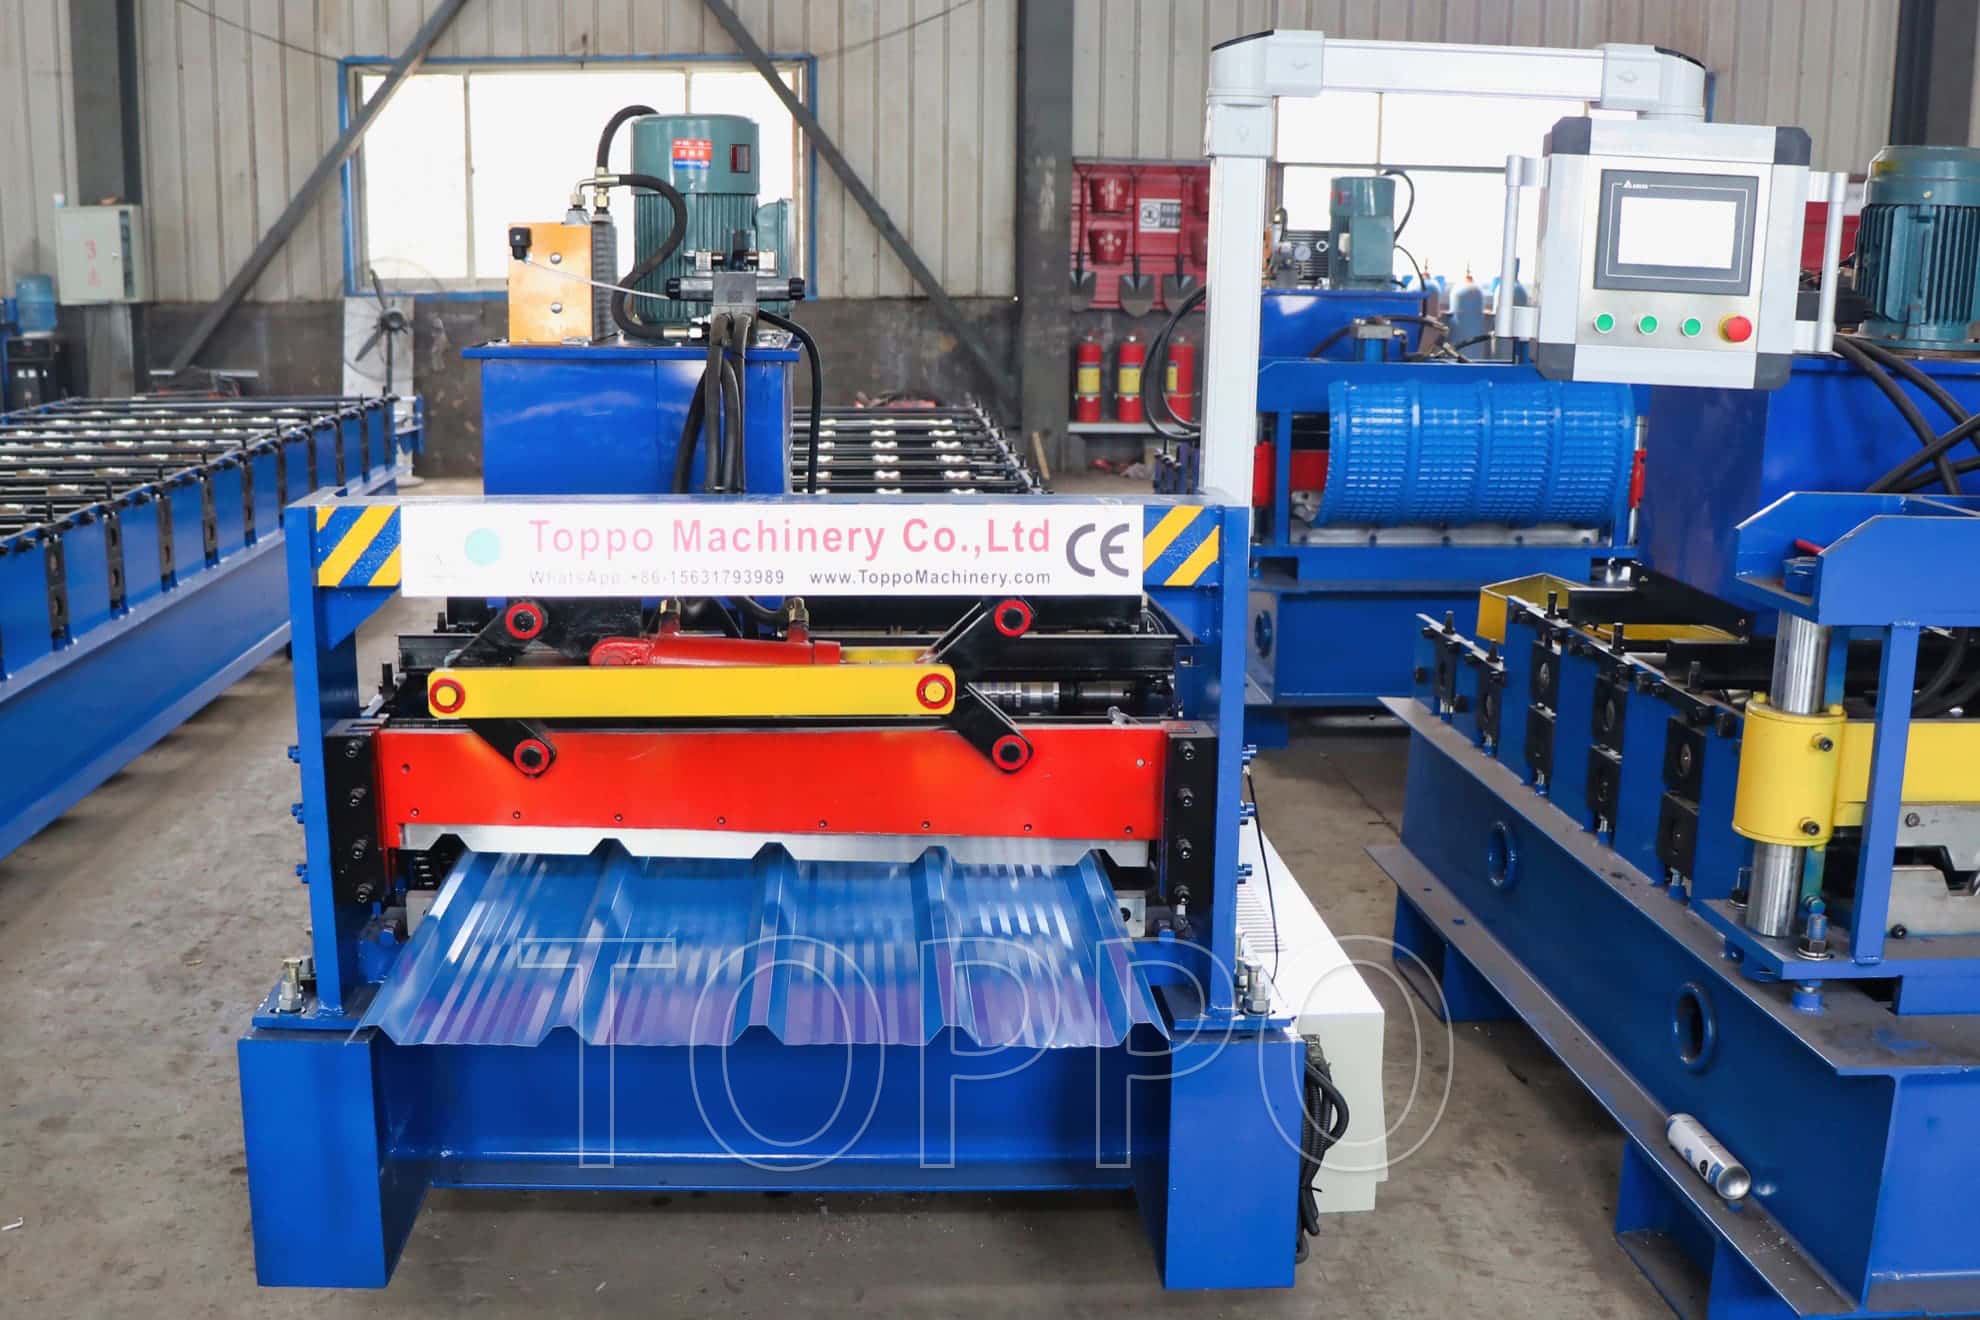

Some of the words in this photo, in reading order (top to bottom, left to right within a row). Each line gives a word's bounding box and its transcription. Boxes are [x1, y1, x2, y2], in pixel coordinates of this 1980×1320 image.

[528, 519, 654, 561] Toppo
[672, 518, 886, 562] Machinery
[902, 517, 1050, 561] Co.,Ltd
[1065, 522, 1130, 578] CE
[809, 568, 1050, 589] www.ToppoMachinery.com
